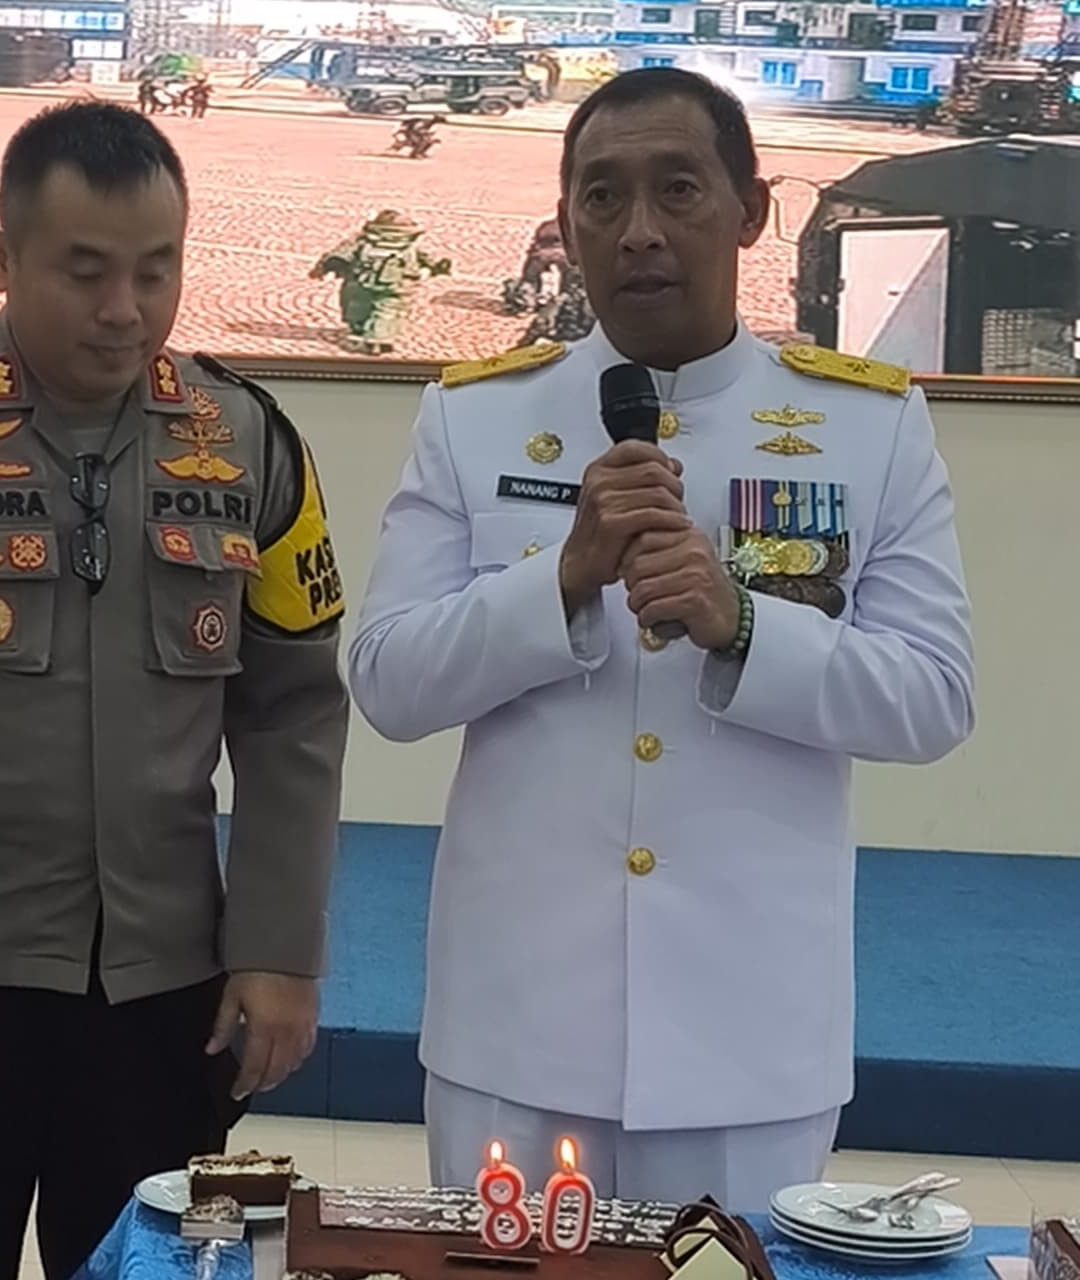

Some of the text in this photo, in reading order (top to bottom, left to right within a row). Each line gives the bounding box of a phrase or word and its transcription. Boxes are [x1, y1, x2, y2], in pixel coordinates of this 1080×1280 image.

[510, 481, 559, 499] NANANG
[152, 491, 251, 524] POLRI
[474, 1163, 598, 1257] 80
